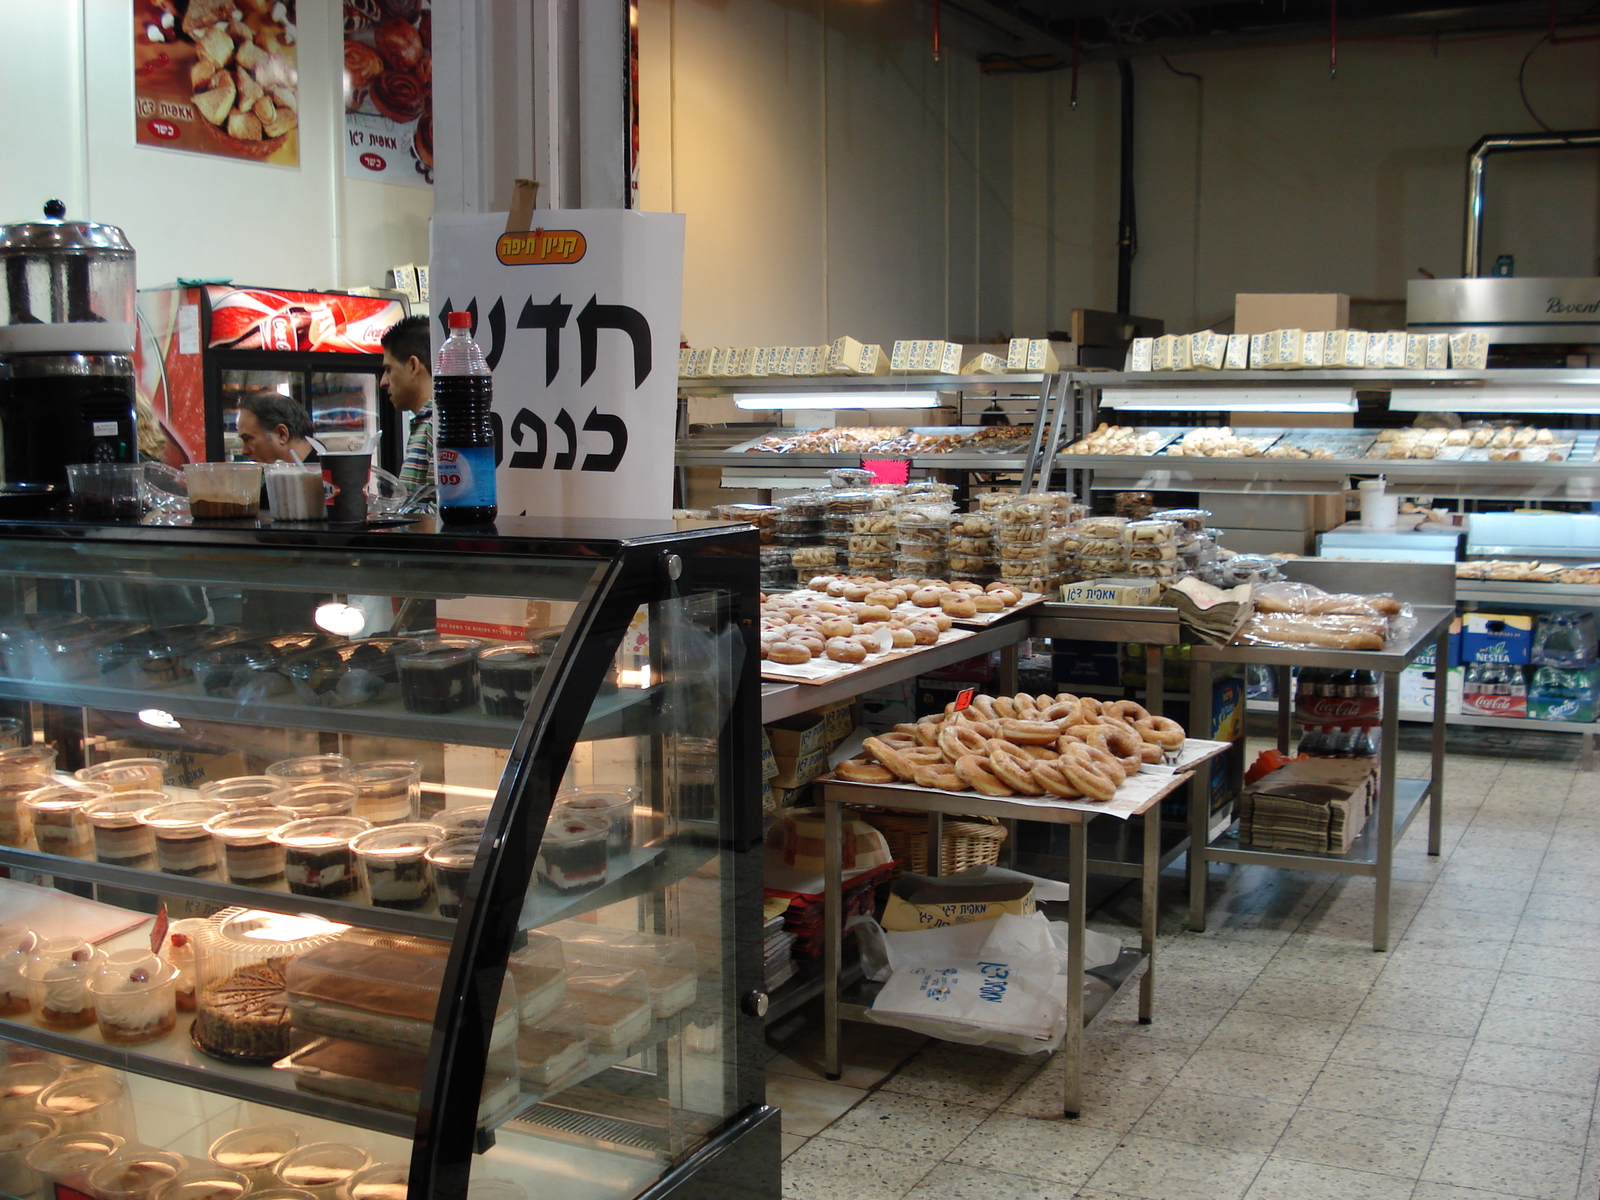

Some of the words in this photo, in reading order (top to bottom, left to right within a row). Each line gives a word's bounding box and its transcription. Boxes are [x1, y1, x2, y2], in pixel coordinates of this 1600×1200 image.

[153, 124, 174, 136] כשר
[364, 156, 382, 168] כשר
[502, 238, 536, 256] חיפה
[540, 236, 578, 259] קניון
[491, 406, 628, 472] כנפ
[1086, 588, 1116, 600] מאפית
[1476, 652, 1510, 662] NESTEA
[1548, 700, 1576, 716] Sprite
[960, 904, 986, 914] מאפית
